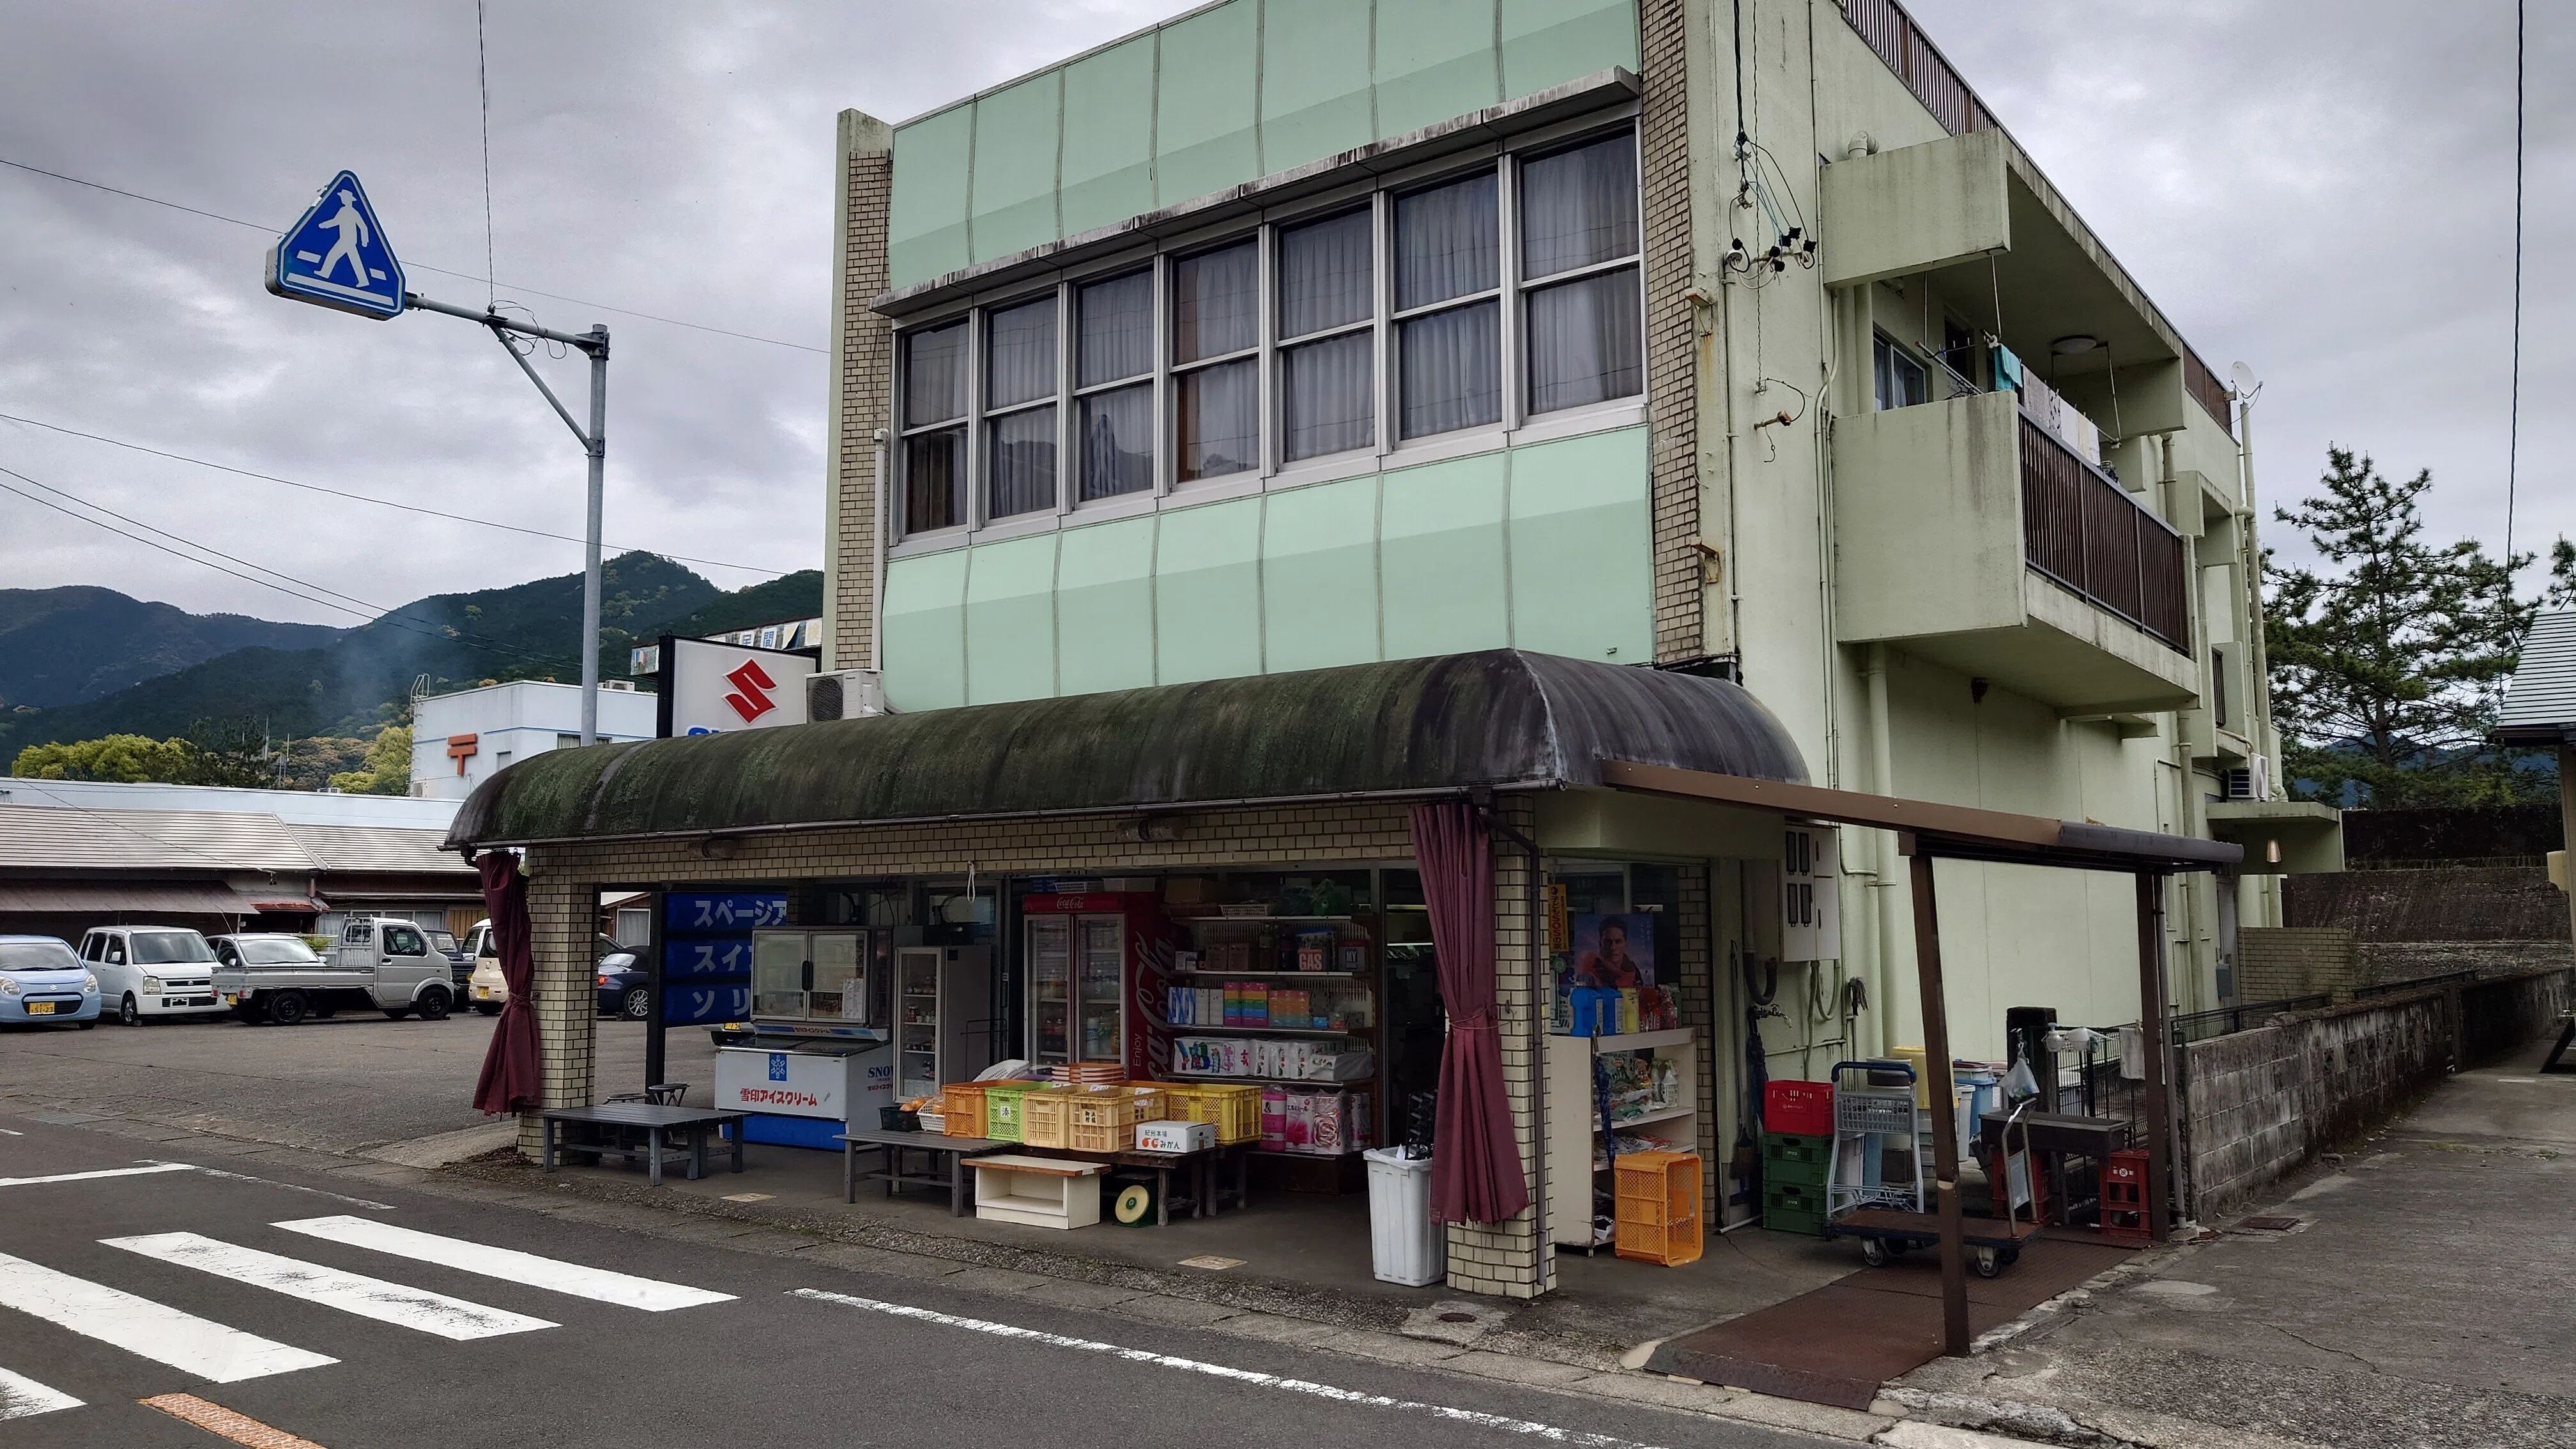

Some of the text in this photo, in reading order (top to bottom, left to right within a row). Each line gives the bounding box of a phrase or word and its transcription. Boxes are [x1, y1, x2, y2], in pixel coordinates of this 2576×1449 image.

[694, 899, 788, 928] スペーシア
[693, 944, 751, 973] スイ
[1299, 953, 1322, 971] GAS
[1133, 1034, 1142, 1067] Enjoy
[740, 1087, 818, 1106] 雪印アイスクリーム
[1160, 1140, 1180, 1149] みかん
